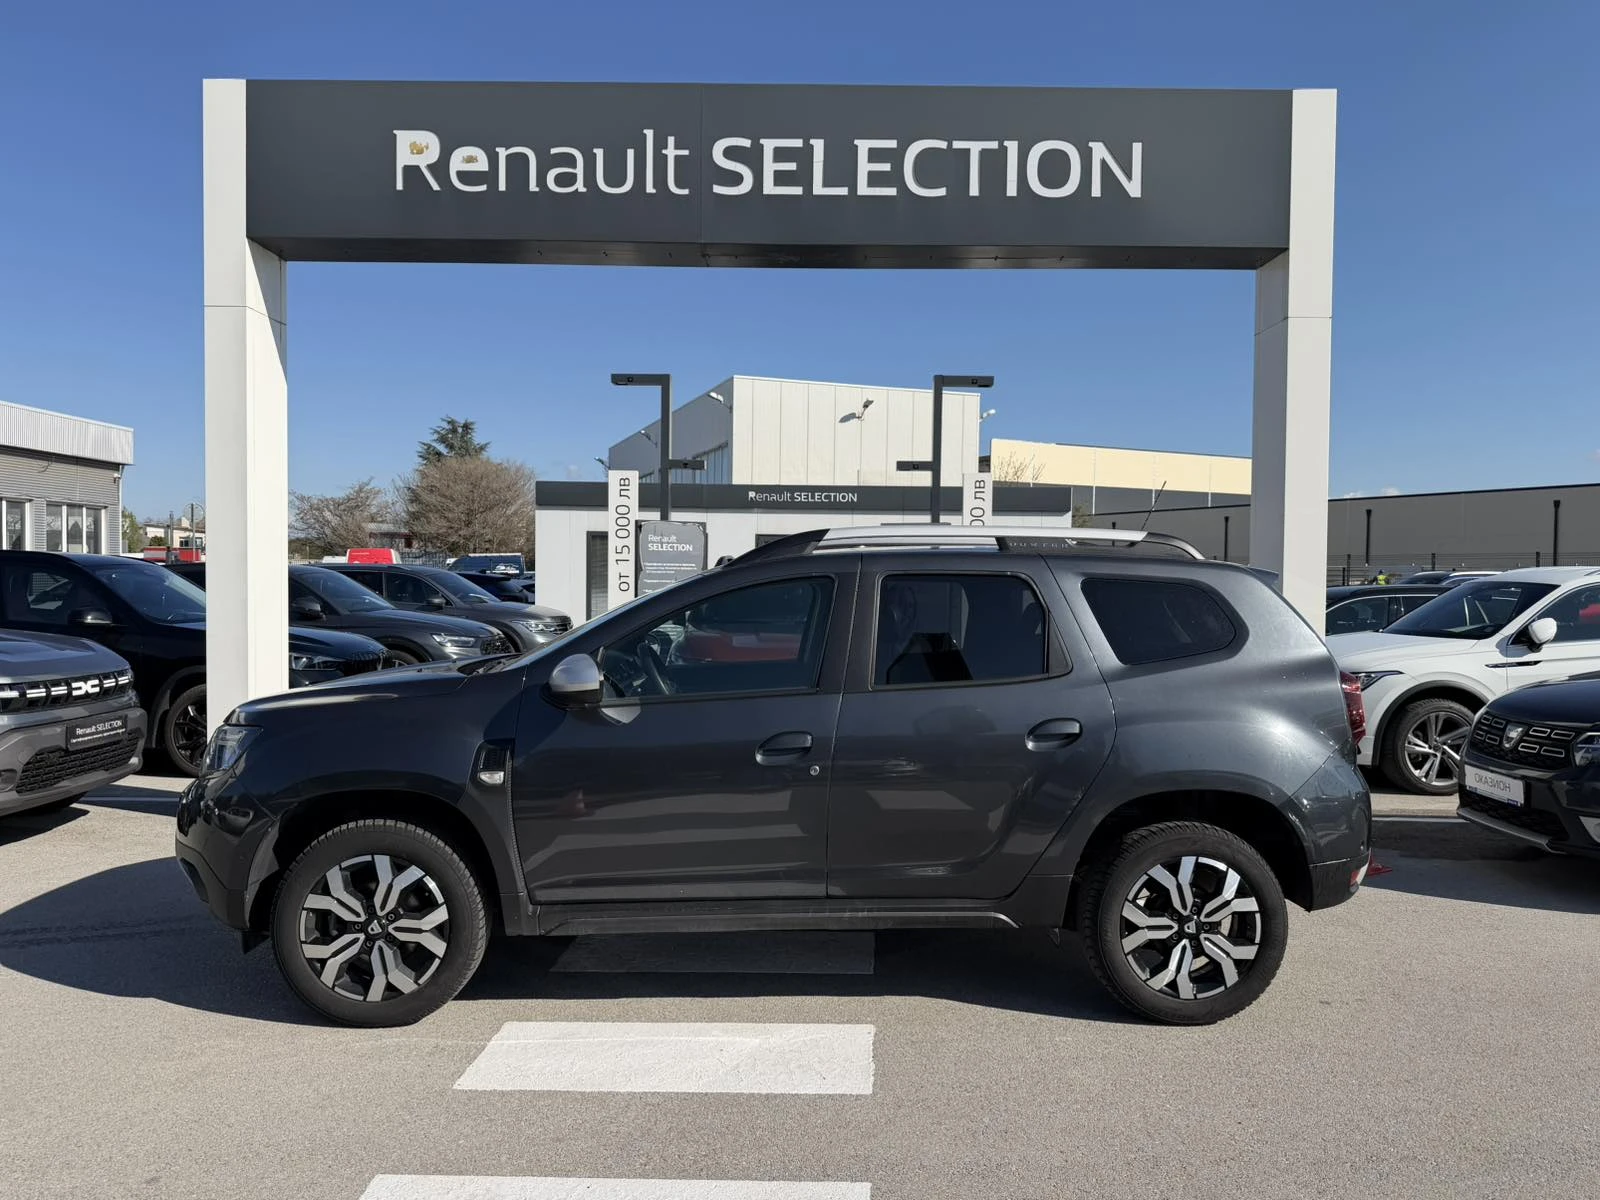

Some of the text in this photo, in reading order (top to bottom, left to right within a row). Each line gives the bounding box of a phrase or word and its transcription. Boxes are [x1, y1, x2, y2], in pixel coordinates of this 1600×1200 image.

[393, 128, 1144, 198] Renault SELECTION
[748, 491, 858, 503] Renault SELECTION
[615, 504, 630, 539] 000
[648, 534, 677, 543] Renault
[648, 543, 693, 552] SELECTION
[615, 545, 630, 565] 15
[1474, 773, 1511, 792] ОКАЗИОН
